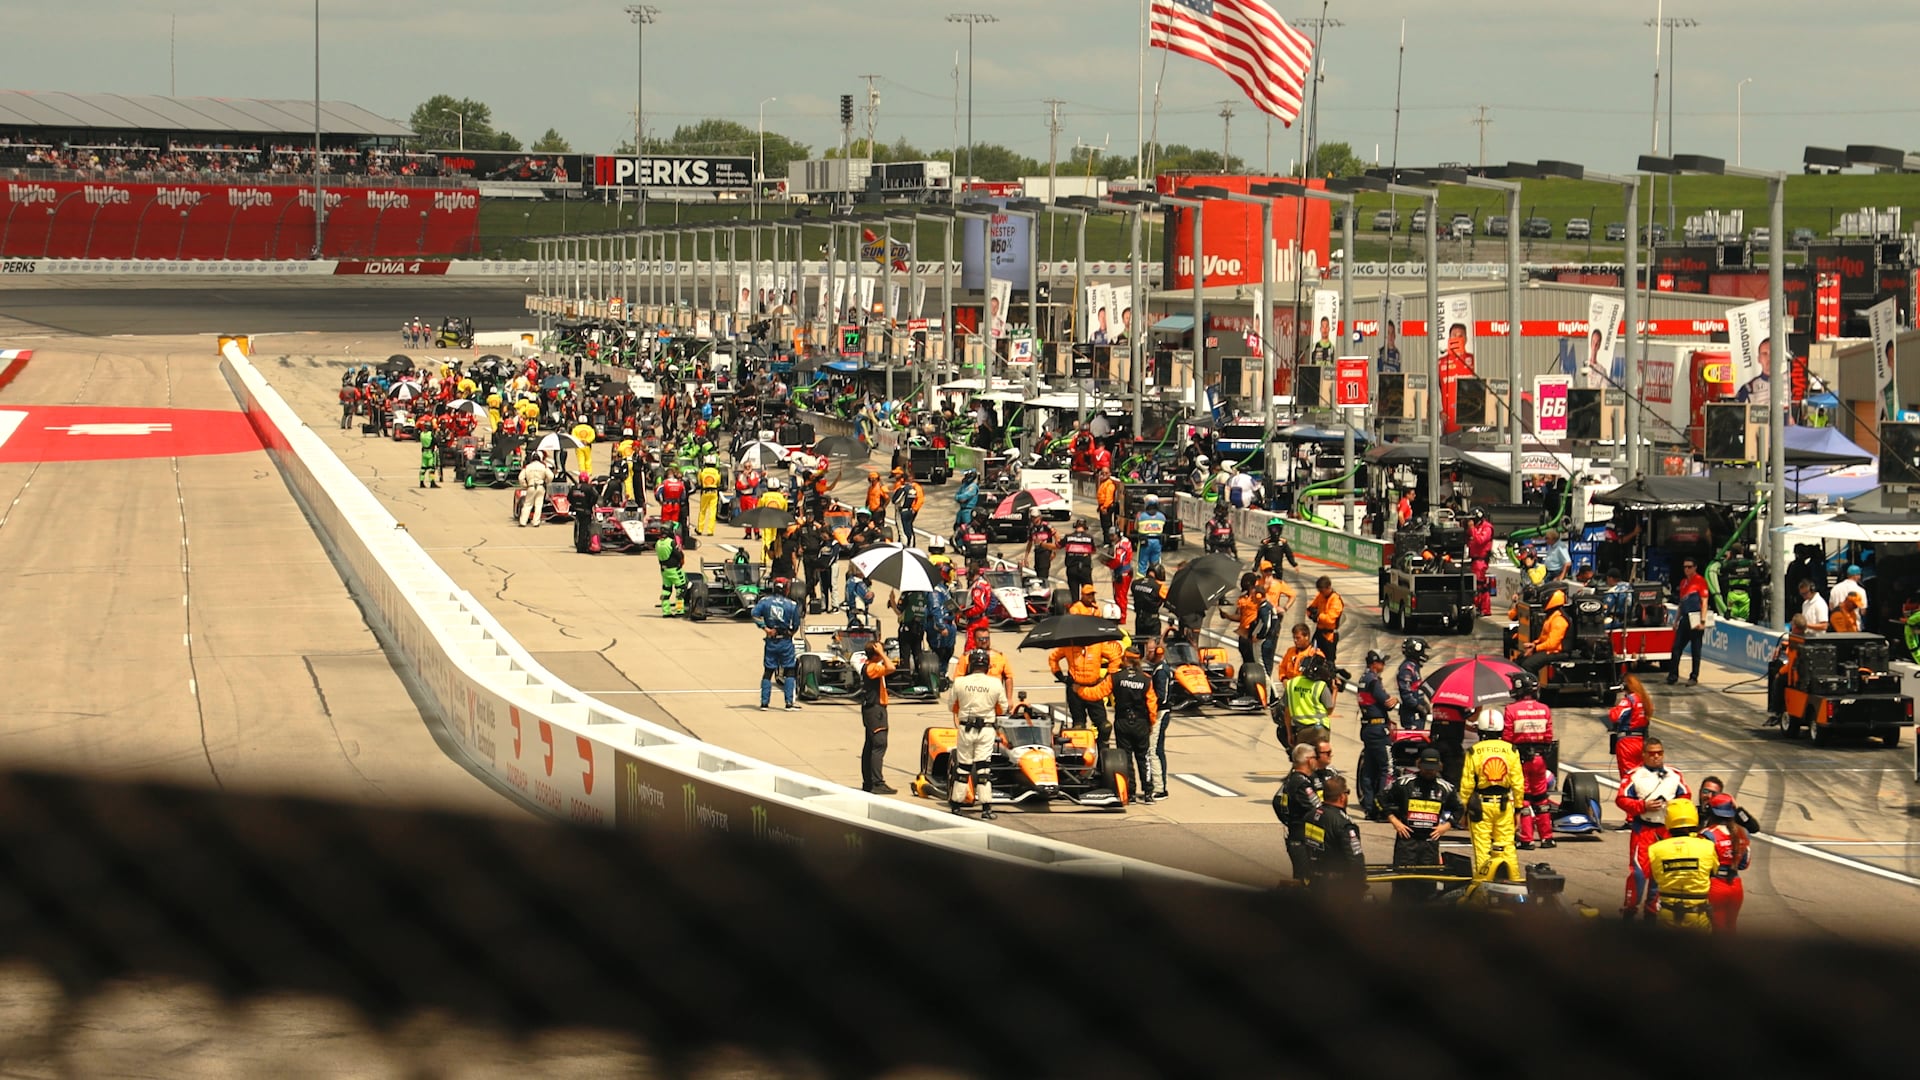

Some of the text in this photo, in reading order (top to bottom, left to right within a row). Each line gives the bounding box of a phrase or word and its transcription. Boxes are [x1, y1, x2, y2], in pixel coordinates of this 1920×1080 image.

[616, 159, 710, 185] PERKS
[863, 246, 906, 257] SUNCO
[2, 261, 36, 273] PERKS
[364, 262, 420, 273] IOWA 4
[1437, 300, 1446, 341] POWER
[845, 333, 860, 345] 77
[1738, 311, 1752, 370] LUNDQVIST
[1346, 381, 1359, 399] 11
[1541, 397, 1567, 418] 66
